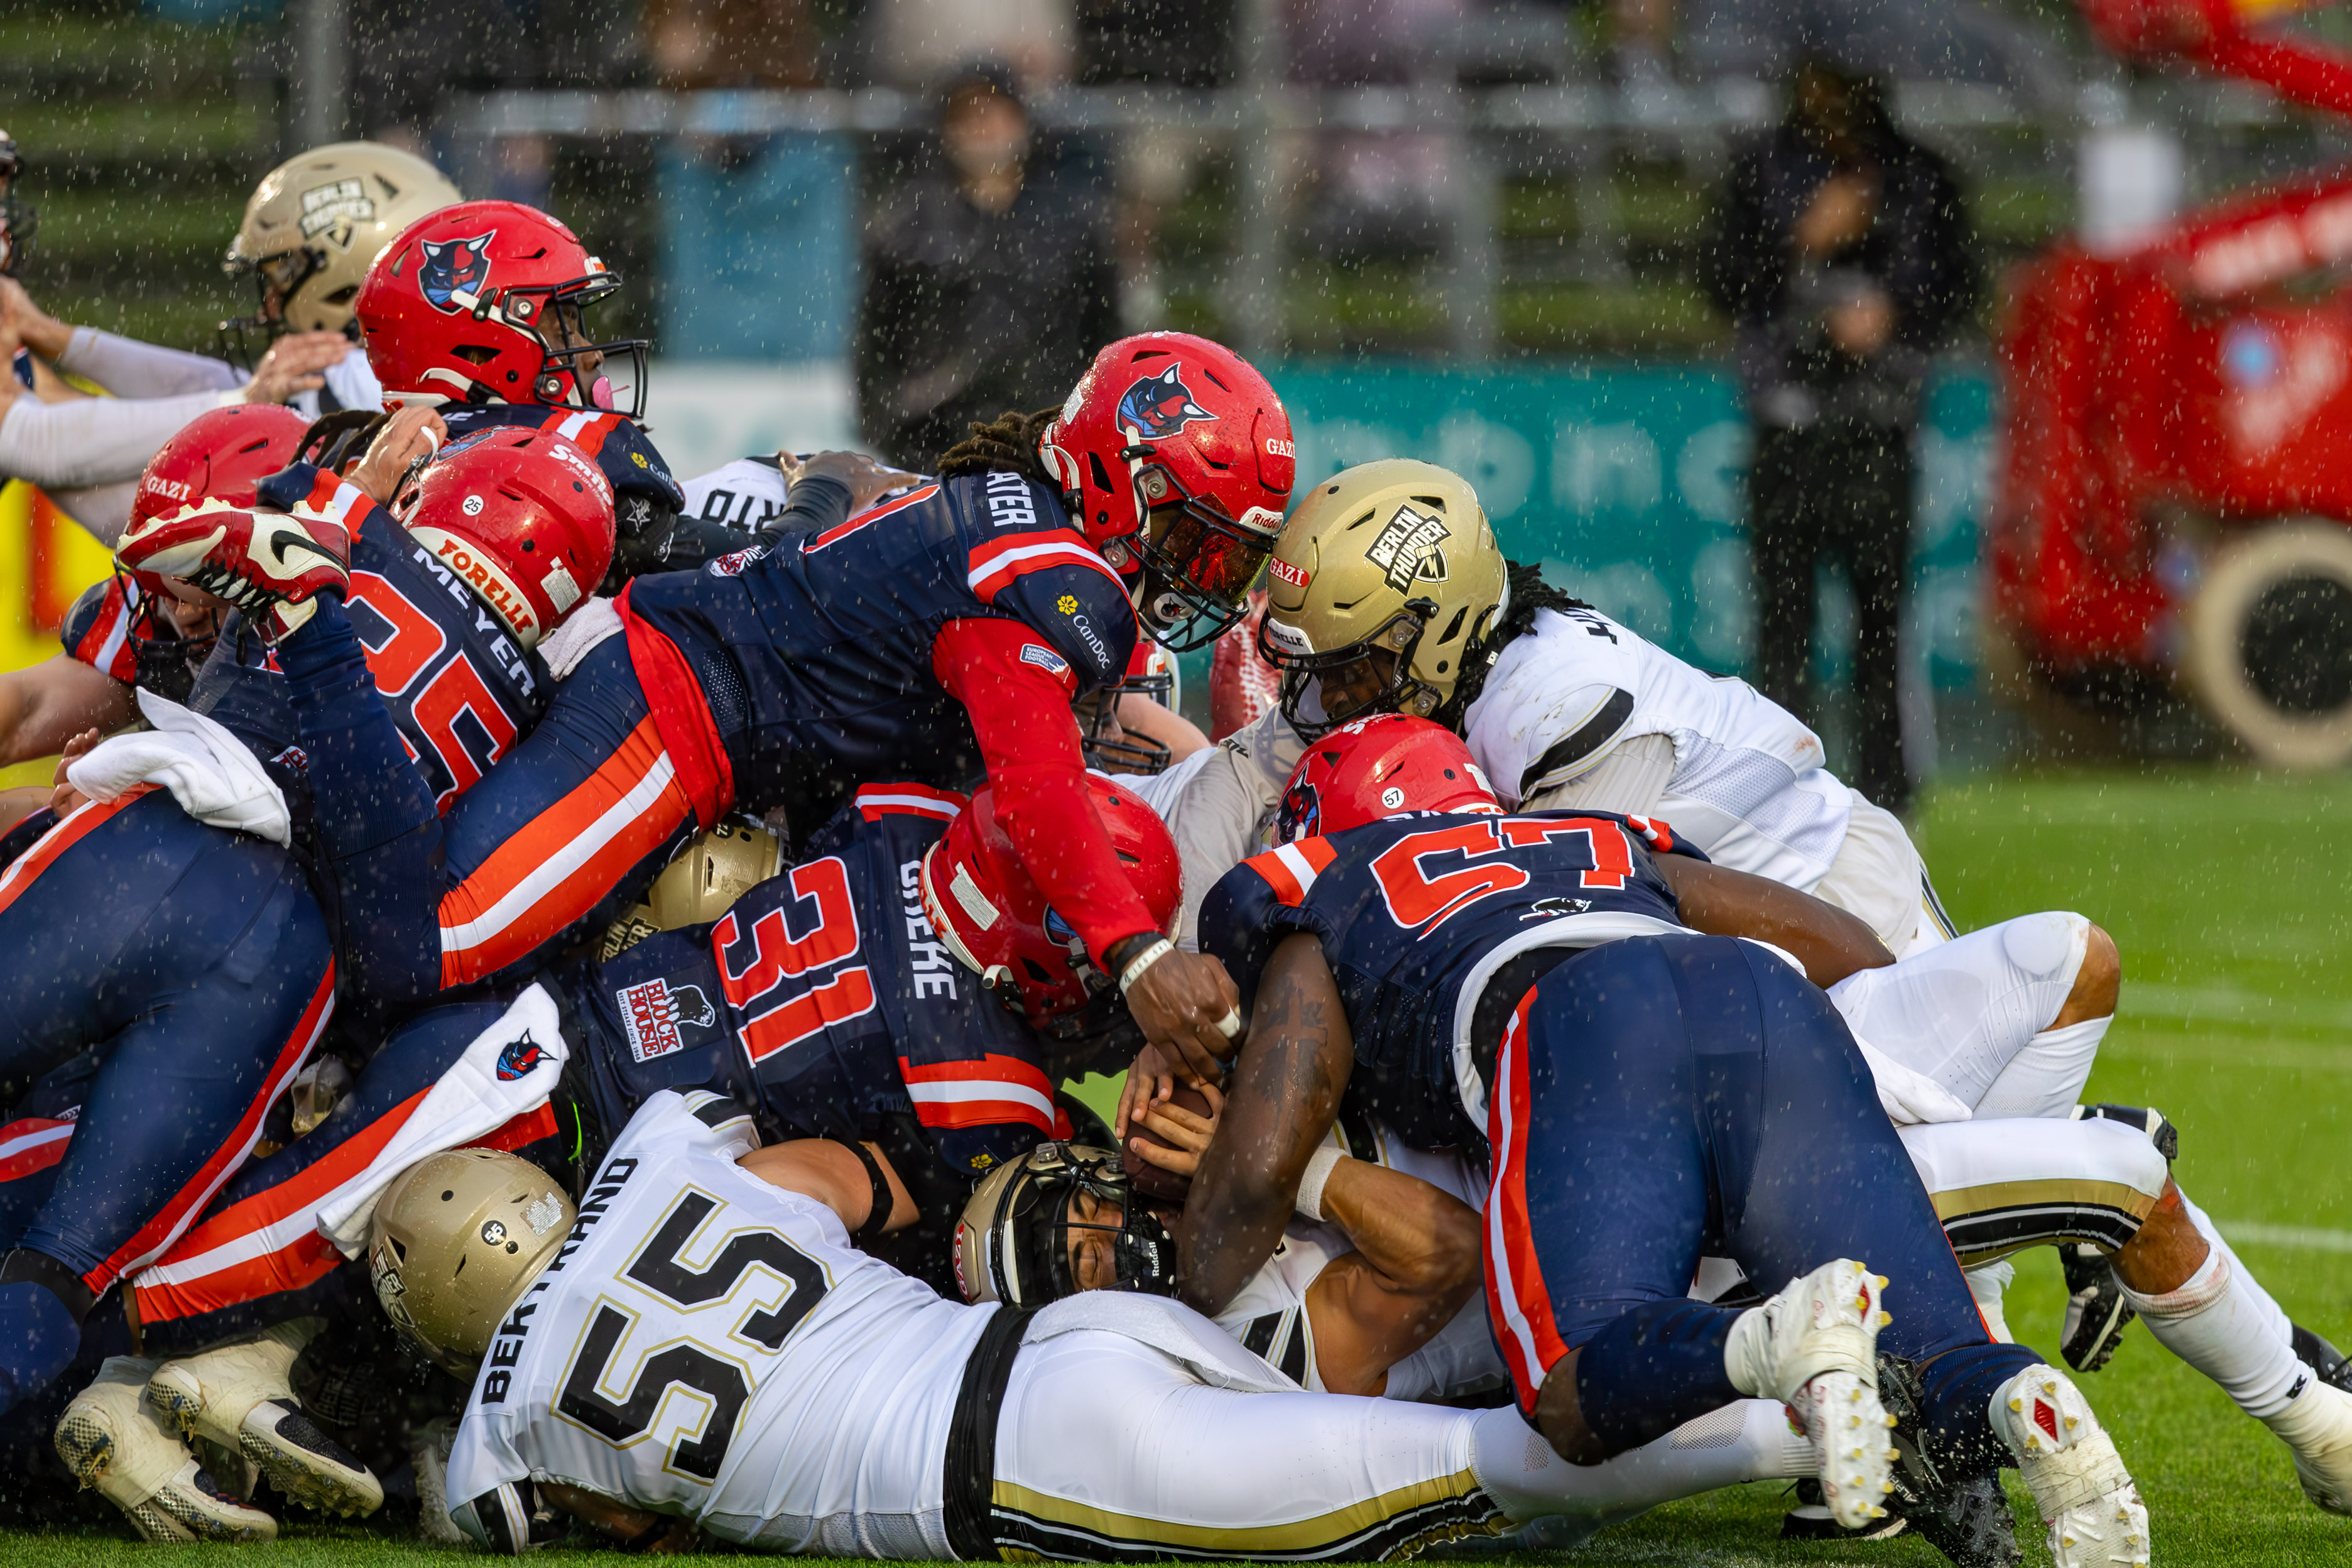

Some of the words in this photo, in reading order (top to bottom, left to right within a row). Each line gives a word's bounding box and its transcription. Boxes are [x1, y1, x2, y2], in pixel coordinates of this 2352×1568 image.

[466, 499, 481, 513] 25
[987, 468, 1037, 526] ATER
[1370, 508, 1424, 569] BERLIN
[1390, 520, 1448, 589] THUNDER
[438, 538, 534, 634] FORELLE
[413, 547, 535, 697] MEYER
[1073, 614, 1111, 670] CanDoc
[1025, 651, 1045, 660] LEAGUE
[1025, 655, 1049, 667] FOOTBALL
[1026, 646, 1054, 660] EUROPEAN
[1384, 790, 1401, 806] 57
[1368, 818, 1636, 941] 57
[710, 855, 878, 1069] 31
[622, 1006, 632, 1026] STEAKS
[628, 1028, 637, 1045] SINCE
[626, 986, 662, 1058] HOUSE
[645, 979, 680, 1053] BLOCK
[484, 1222, 504, 1244] 55
[1148, 1241, 1160, 1277] Riddell
[548, 1182, 837, 1488] 55
